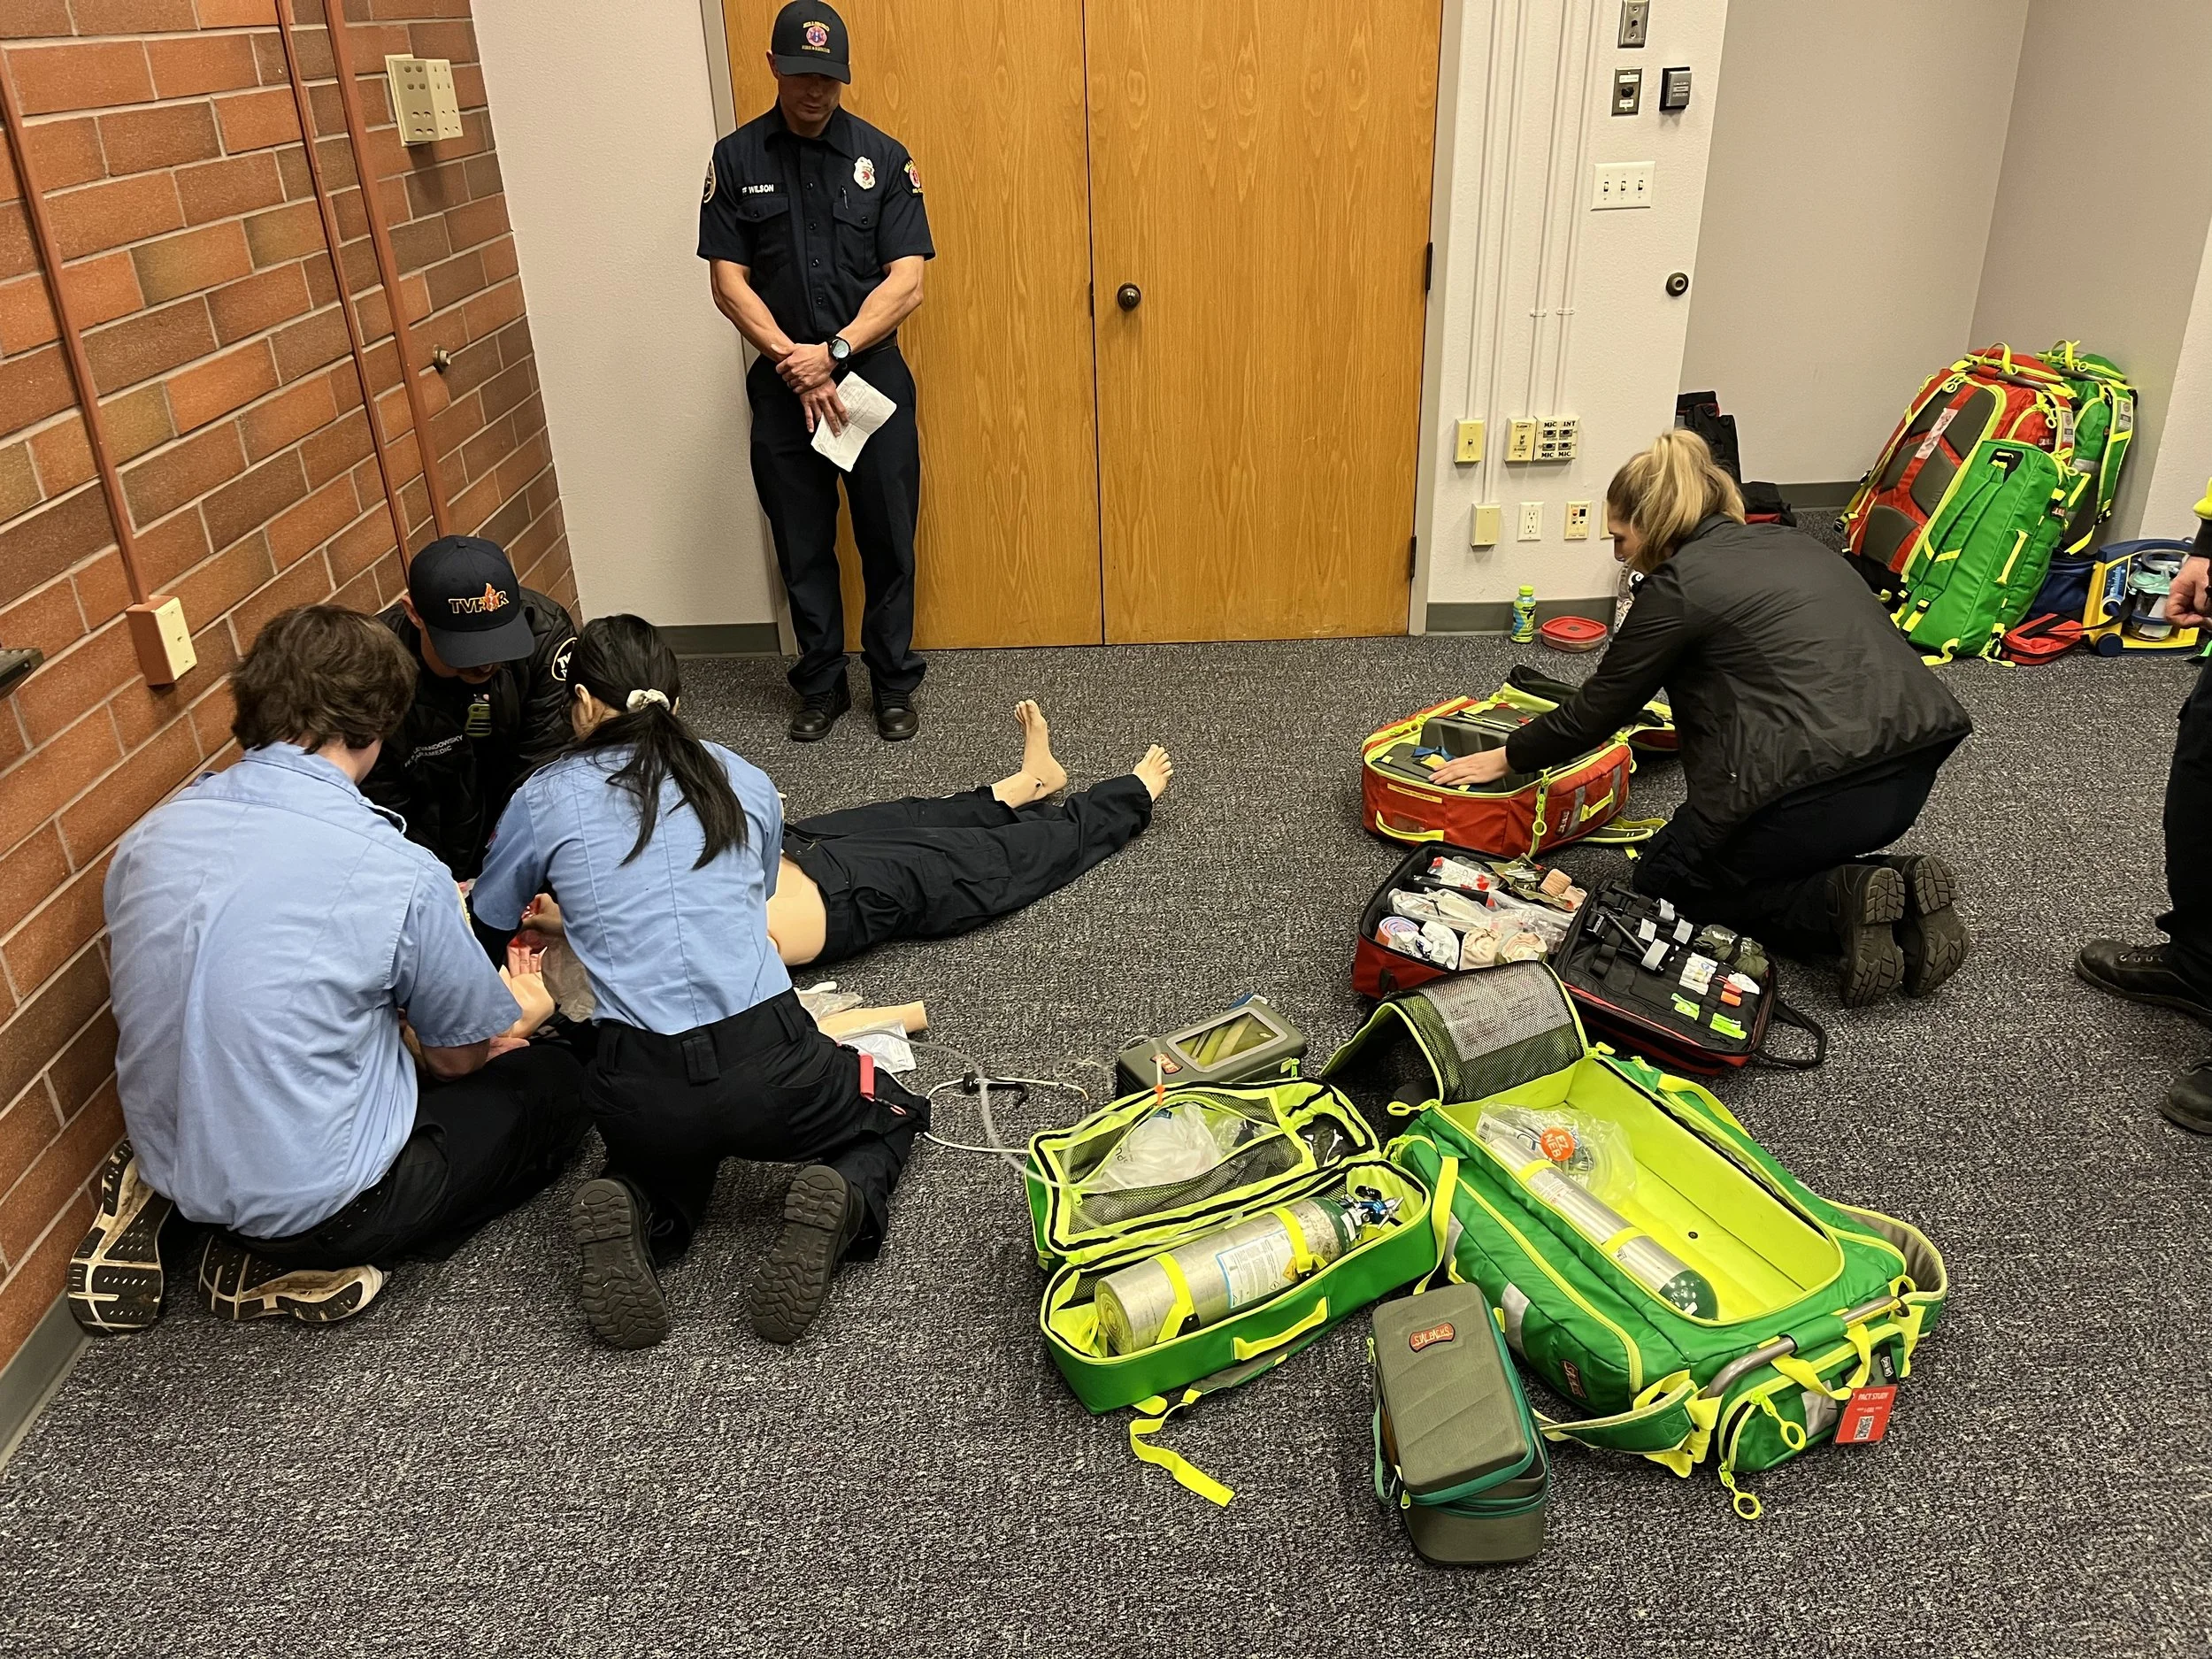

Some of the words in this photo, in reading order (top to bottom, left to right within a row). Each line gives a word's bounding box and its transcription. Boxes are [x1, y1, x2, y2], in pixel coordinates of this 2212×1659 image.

[748, 184, 774, 194] WILSON
[1544, 1133, 1563, 1158] NEB
[1555, 1134, 1570, 1153] EZ
